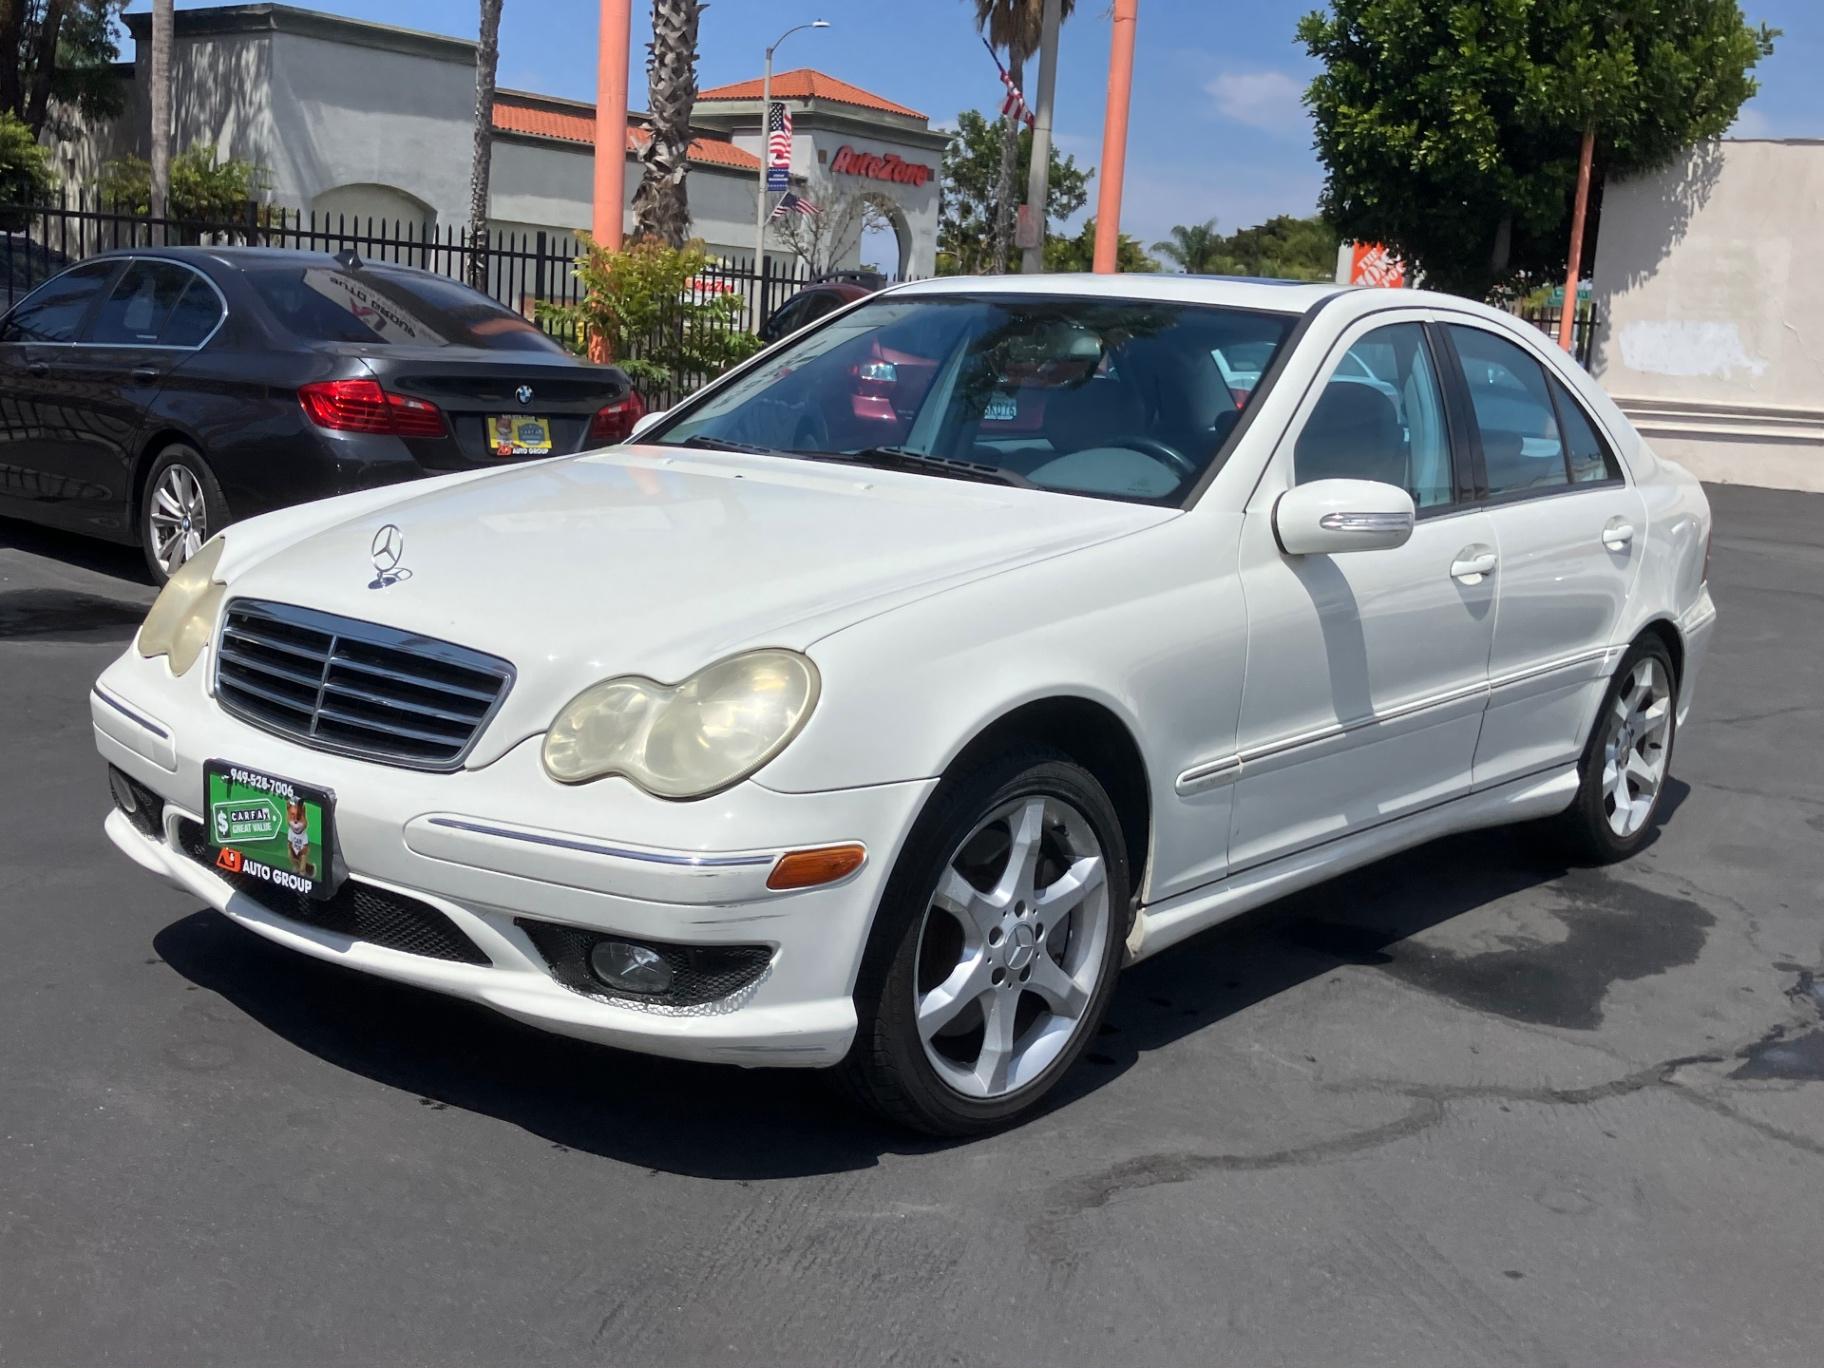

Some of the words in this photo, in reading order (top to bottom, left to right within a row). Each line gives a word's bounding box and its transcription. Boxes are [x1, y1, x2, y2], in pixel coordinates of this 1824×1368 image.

[831, 144, 929, 187] AutoZone
[528, 447, 549, 455] GROUP
[230, 767, 294, 798] 949-528-7006
[231, 808, 270, 822] CARFAX
[232, 823, 252, 833] GREAT
[252, 821, 272, 832] VALUE
[242, 859, 270, 880] AUTO
[272, 869, 313, 894] GROUP
